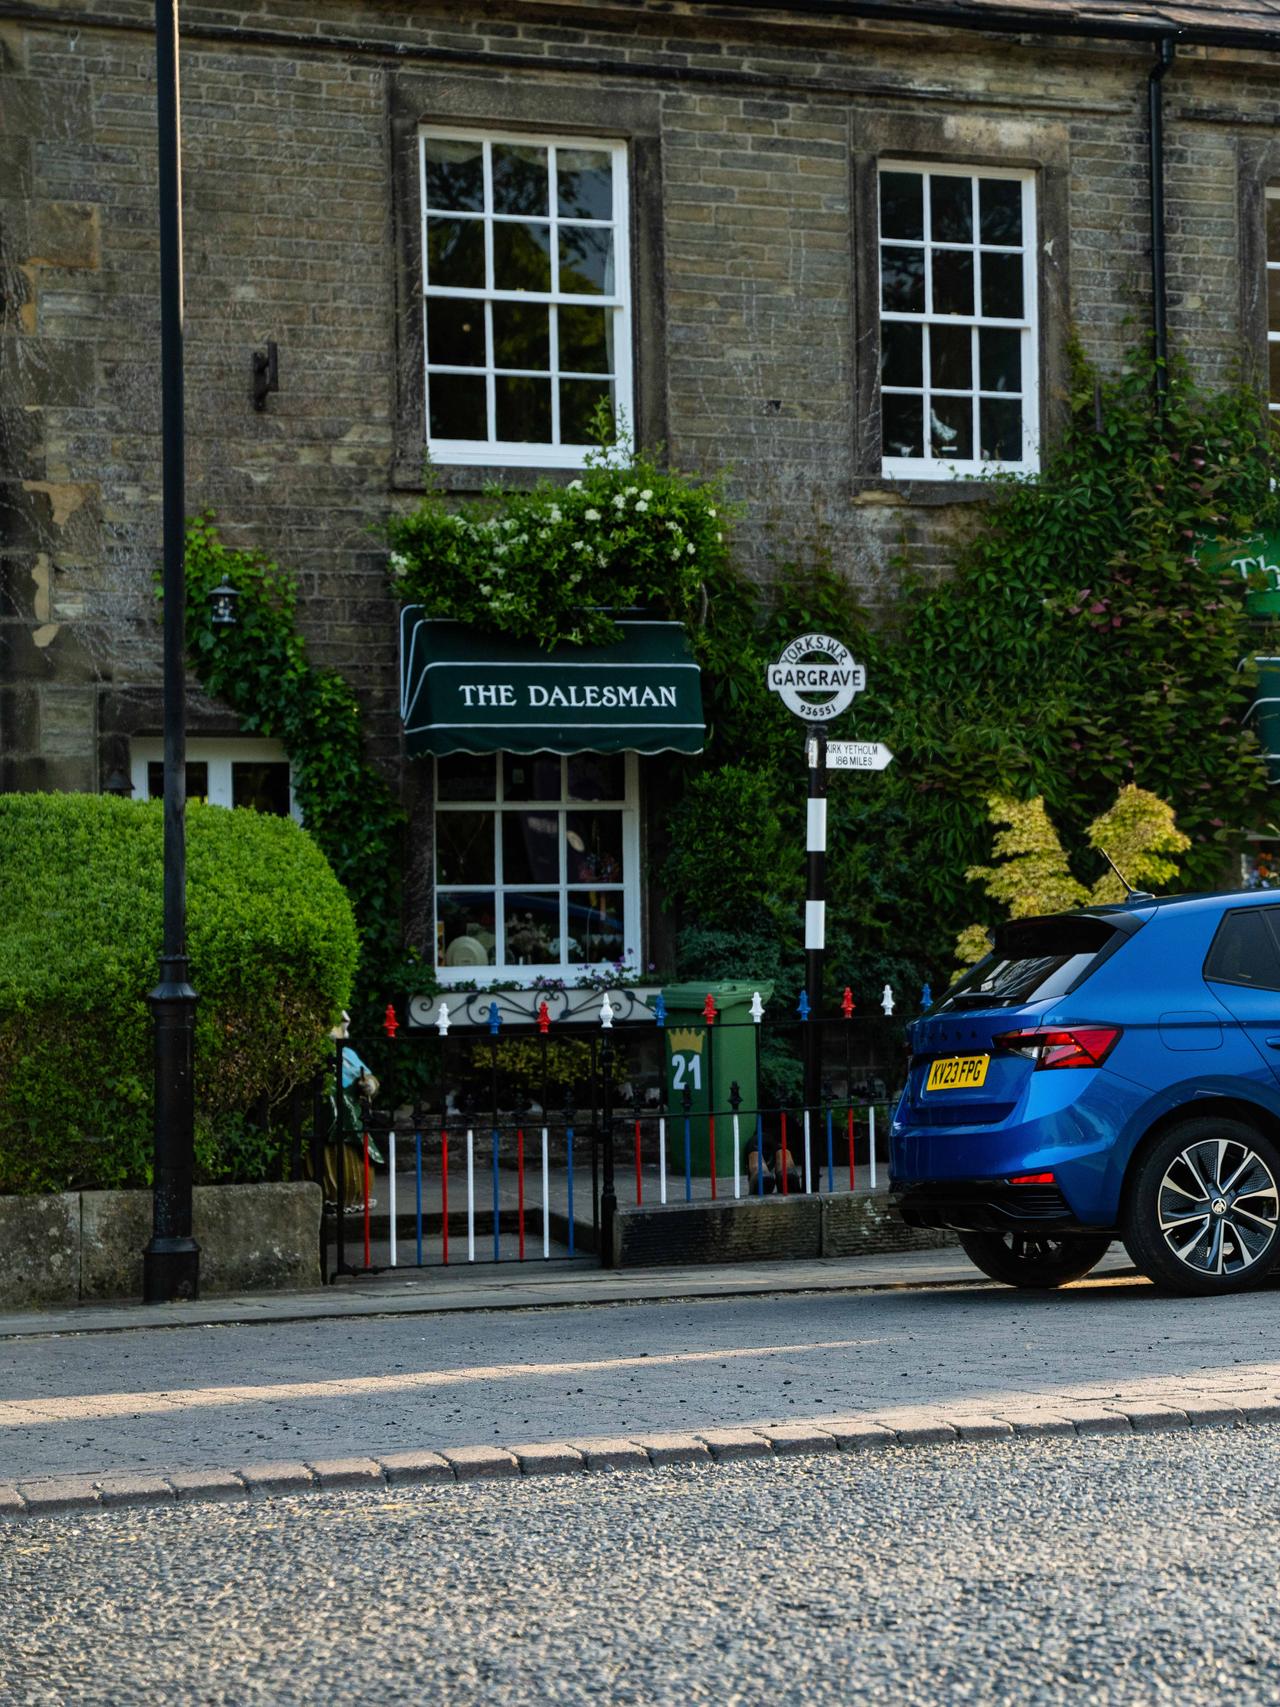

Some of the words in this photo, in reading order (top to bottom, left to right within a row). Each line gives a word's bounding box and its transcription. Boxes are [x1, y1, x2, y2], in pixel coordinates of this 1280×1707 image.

[772, 669, 862, 687] GARGRAVE
[458, 685, 517, 707] THE
[527, 685, 678, 707] DALESMAN
[800, 704, 837, 717] 936551
[826, 743, 842, 754] KIRK
[844, 744, 878, 755] YETHOLM
[849, 756, 873, 767] MILES
[671, 1054, 702, 1090] 21
[932, 1062, 959, 1085] KV23
[958, 1060, 982, 1082] FPG
